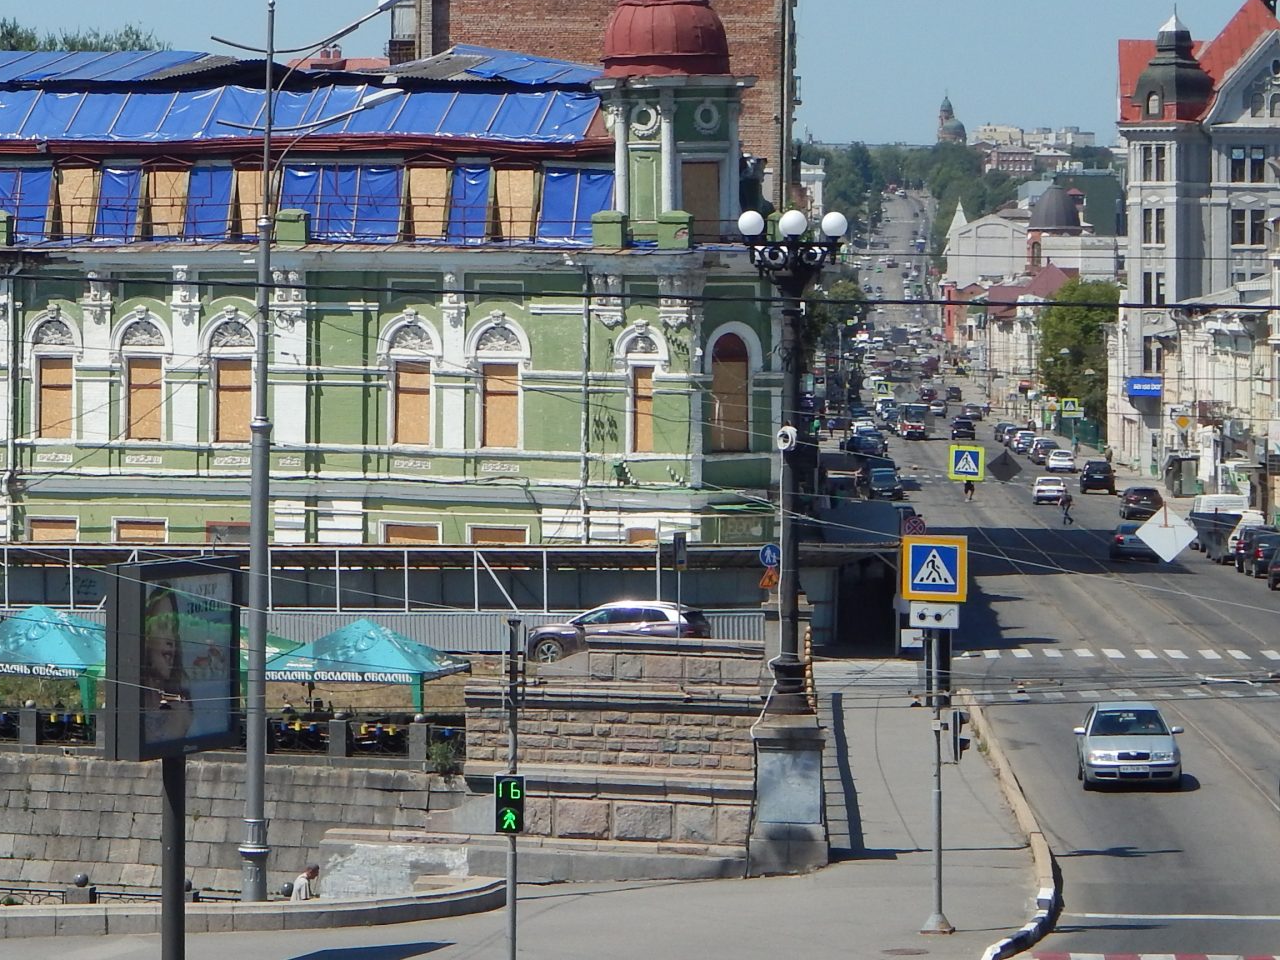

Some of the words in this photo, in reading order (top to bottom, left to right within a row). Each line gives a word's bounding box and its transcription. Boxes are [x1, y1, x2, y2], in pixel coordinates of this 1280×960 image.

[314, 671, 362, 682] ОБОЛОНЬ
[364, 672, 413, 683] ОБОЛОНЬ
[499, 782, 520, 799] 16
